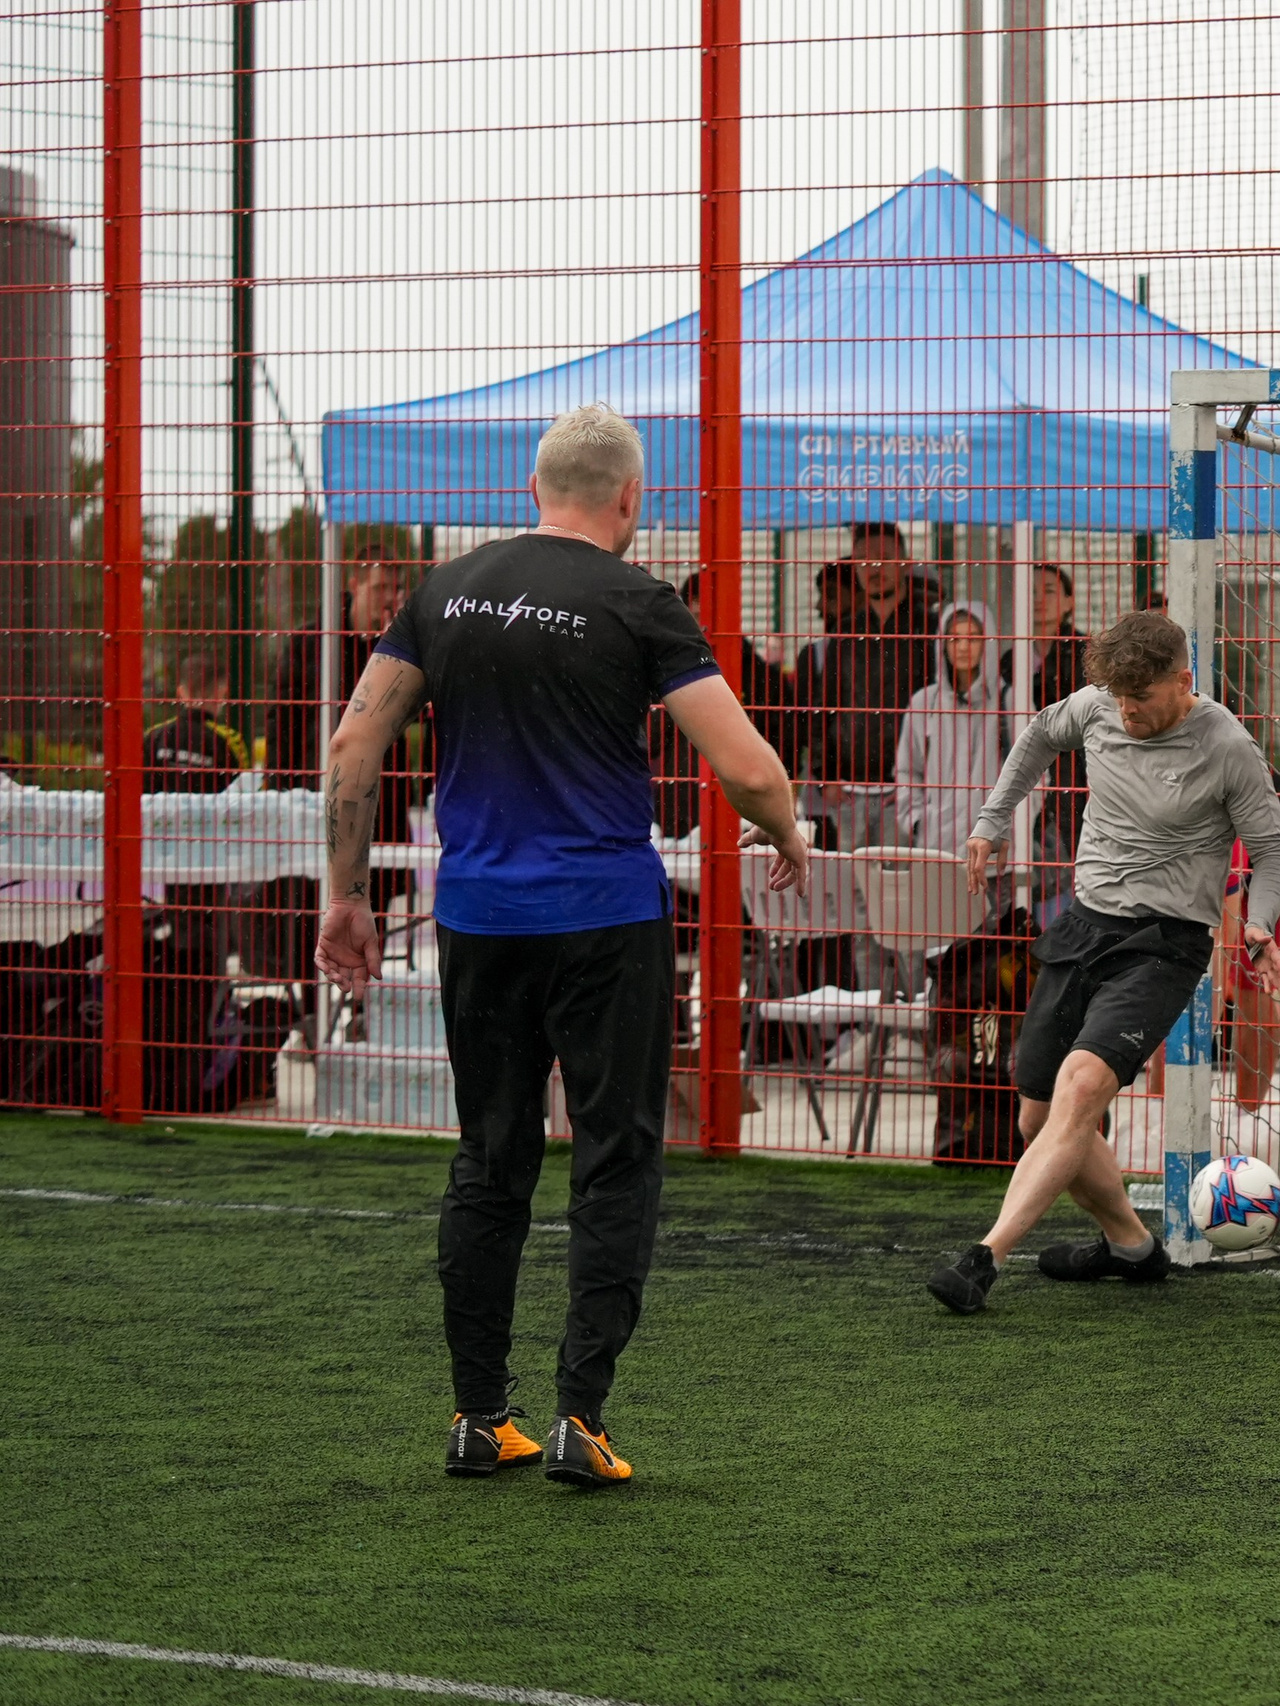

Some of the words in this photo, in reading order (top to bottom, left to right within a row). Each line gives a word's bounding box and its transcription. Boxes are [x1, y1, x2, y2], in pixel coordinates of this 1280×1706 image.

[801, 429, 969, 455] СПРТИВНЫЙ
[799, 464, 969, 502] СИРИУС
[539, 623, 584, 639] TEAM
